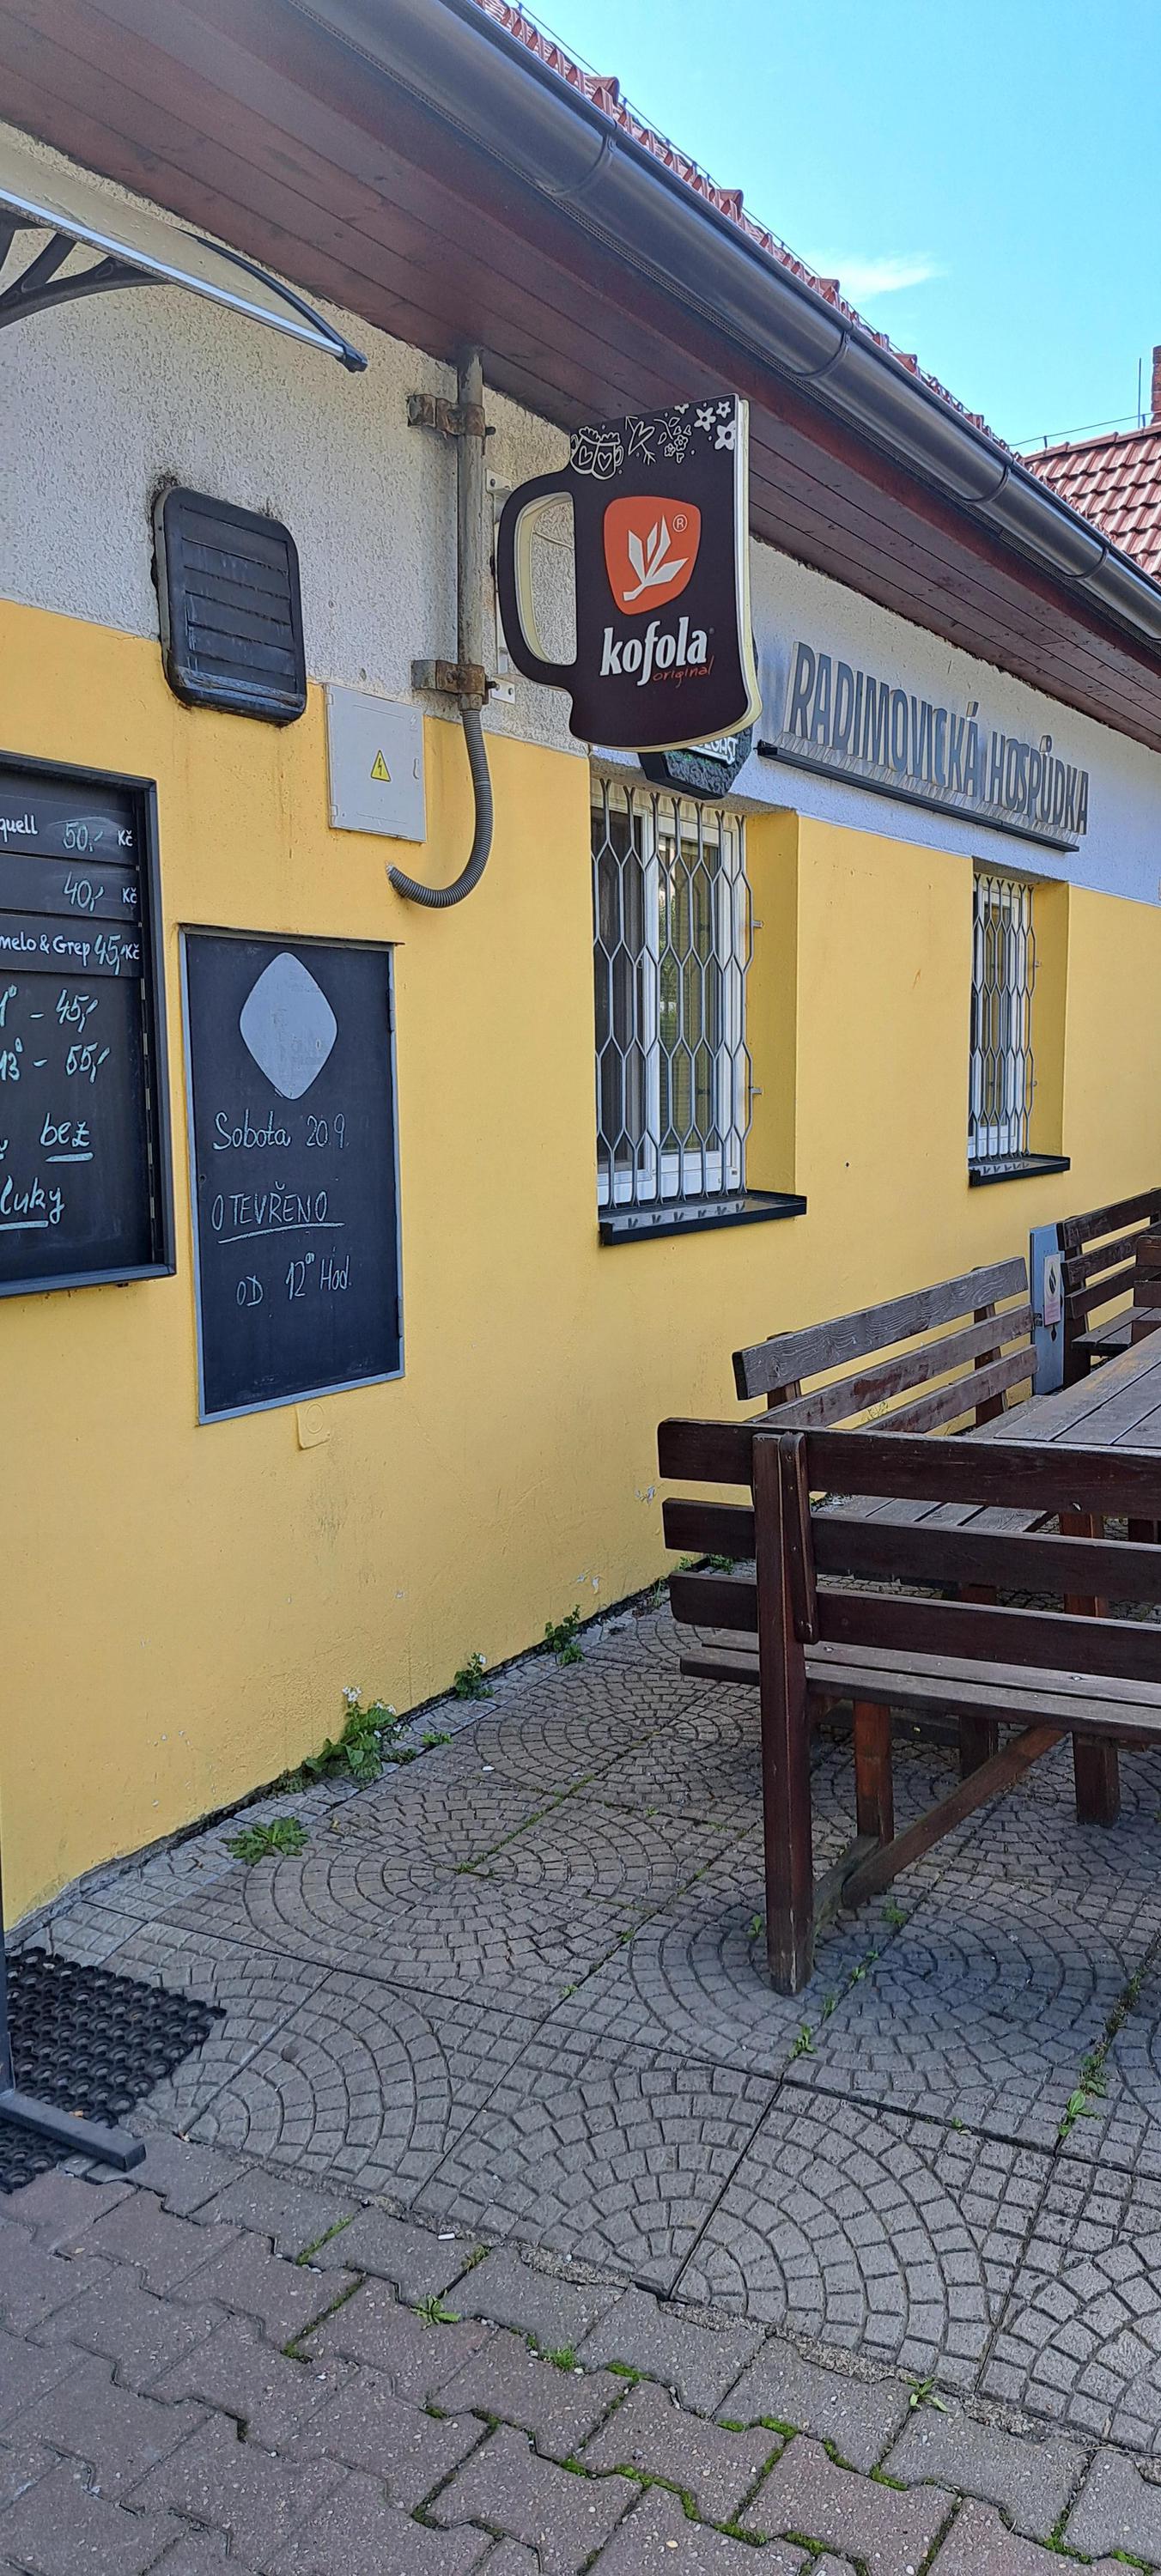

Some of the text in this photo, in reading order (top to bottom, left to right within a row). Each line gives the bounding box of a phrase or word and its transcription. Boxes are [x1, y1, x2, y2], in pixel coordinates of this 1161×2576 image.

[599, 617, 708, 686] kofola
[652, 655, 714, 688] original
[699, 736, 739, 764] GAST
[783, 641, 1089, 835] RADIMOVICKÁ HOSPŮDKA
[117, 829, 134, 847] Kč
[122, 887, 137, 904] Kč
[40, 933, 51, 955] &
[53, 934, 90, 967] Grep
[125, 944, 140, 960] Kč
[40, 1112, 90, 1147] bez
[212, 1108, 292, 1151] Sobota
[0, 1175, 65, 1224] luky
[211, 1180, 328, 1231] OTEVŘENO
[235, 1275, 264, 1307] OD
